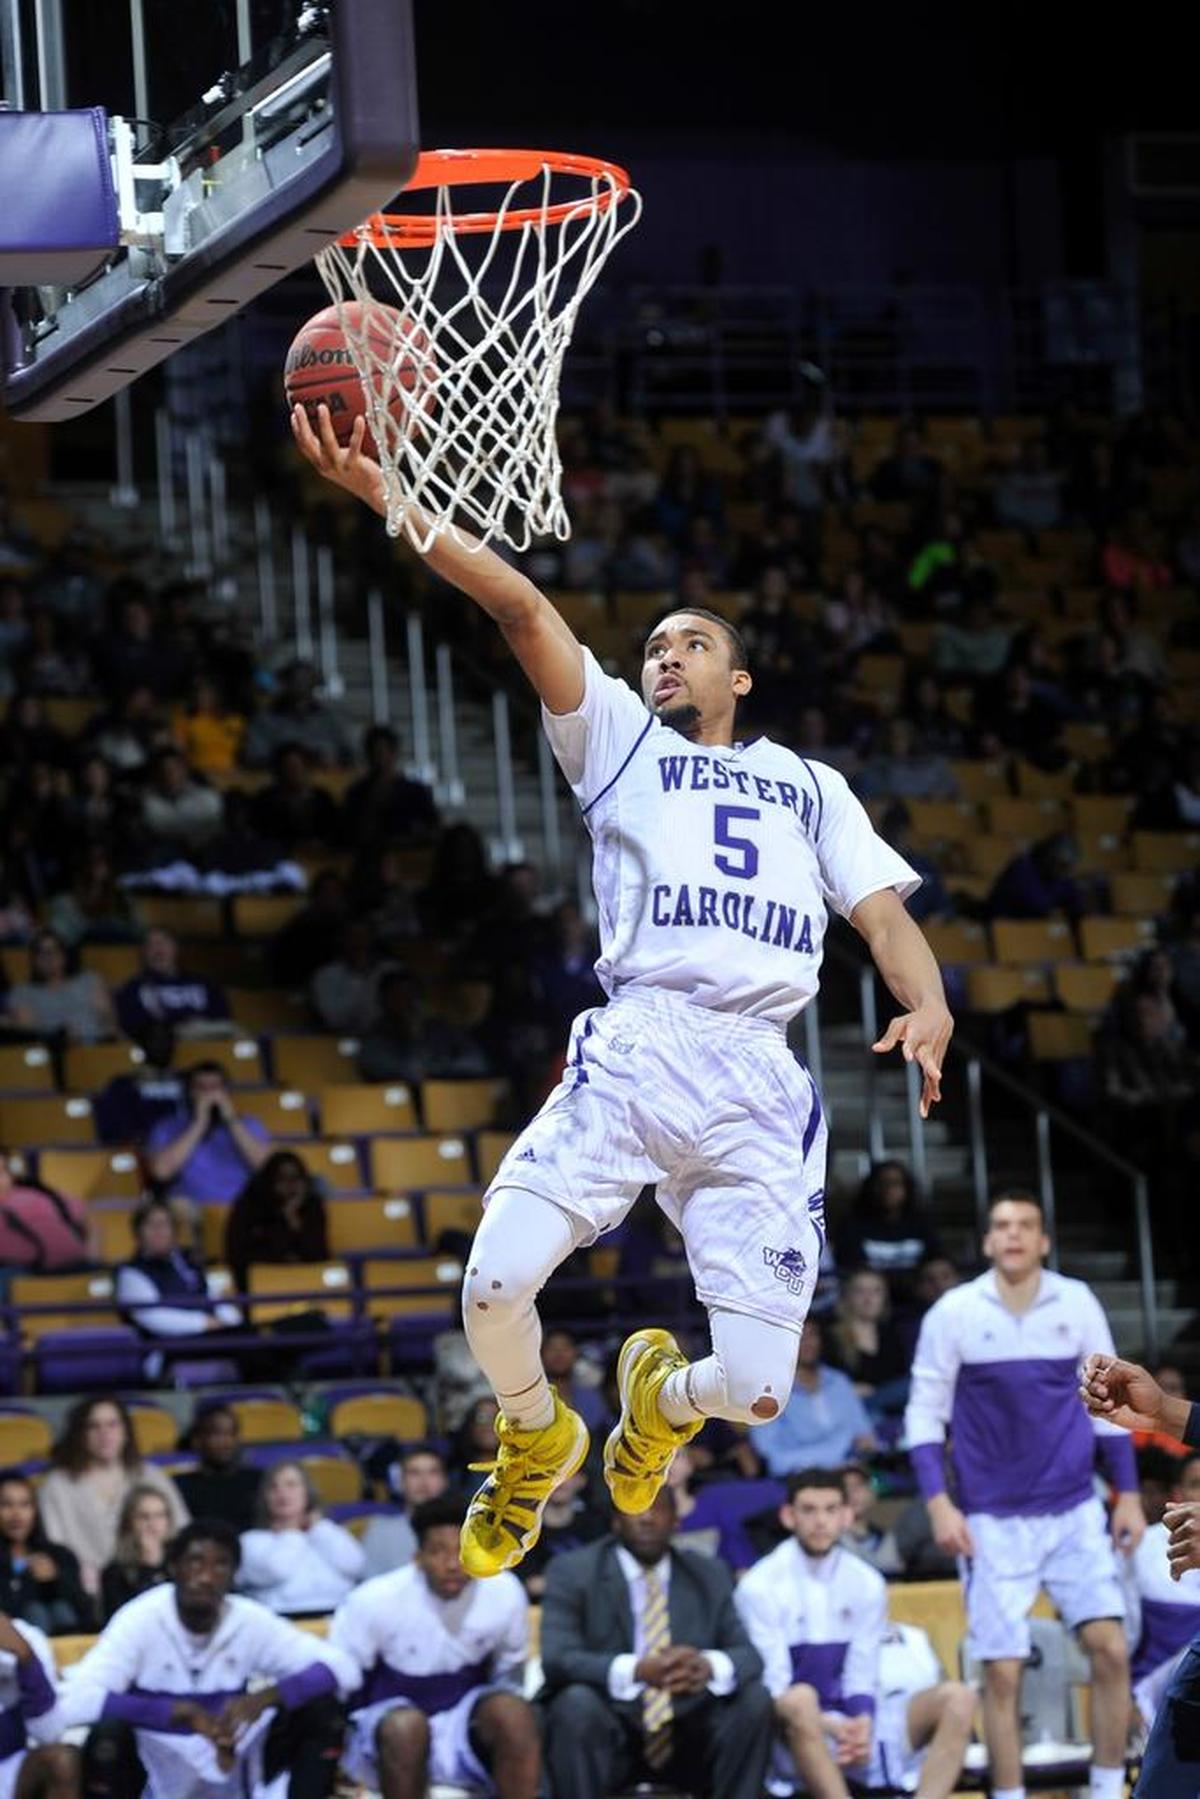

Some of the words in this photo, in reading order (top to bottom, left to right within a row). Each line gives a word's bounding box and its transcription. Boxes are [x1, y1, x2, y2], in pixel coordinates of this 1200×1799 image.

[658, 755, 814, 836] WESTERN
[714, 803, 760, 880] 5
[652, 884, 814, 955] CAROLINA
[763, 1246, 804, 1296] WCU
